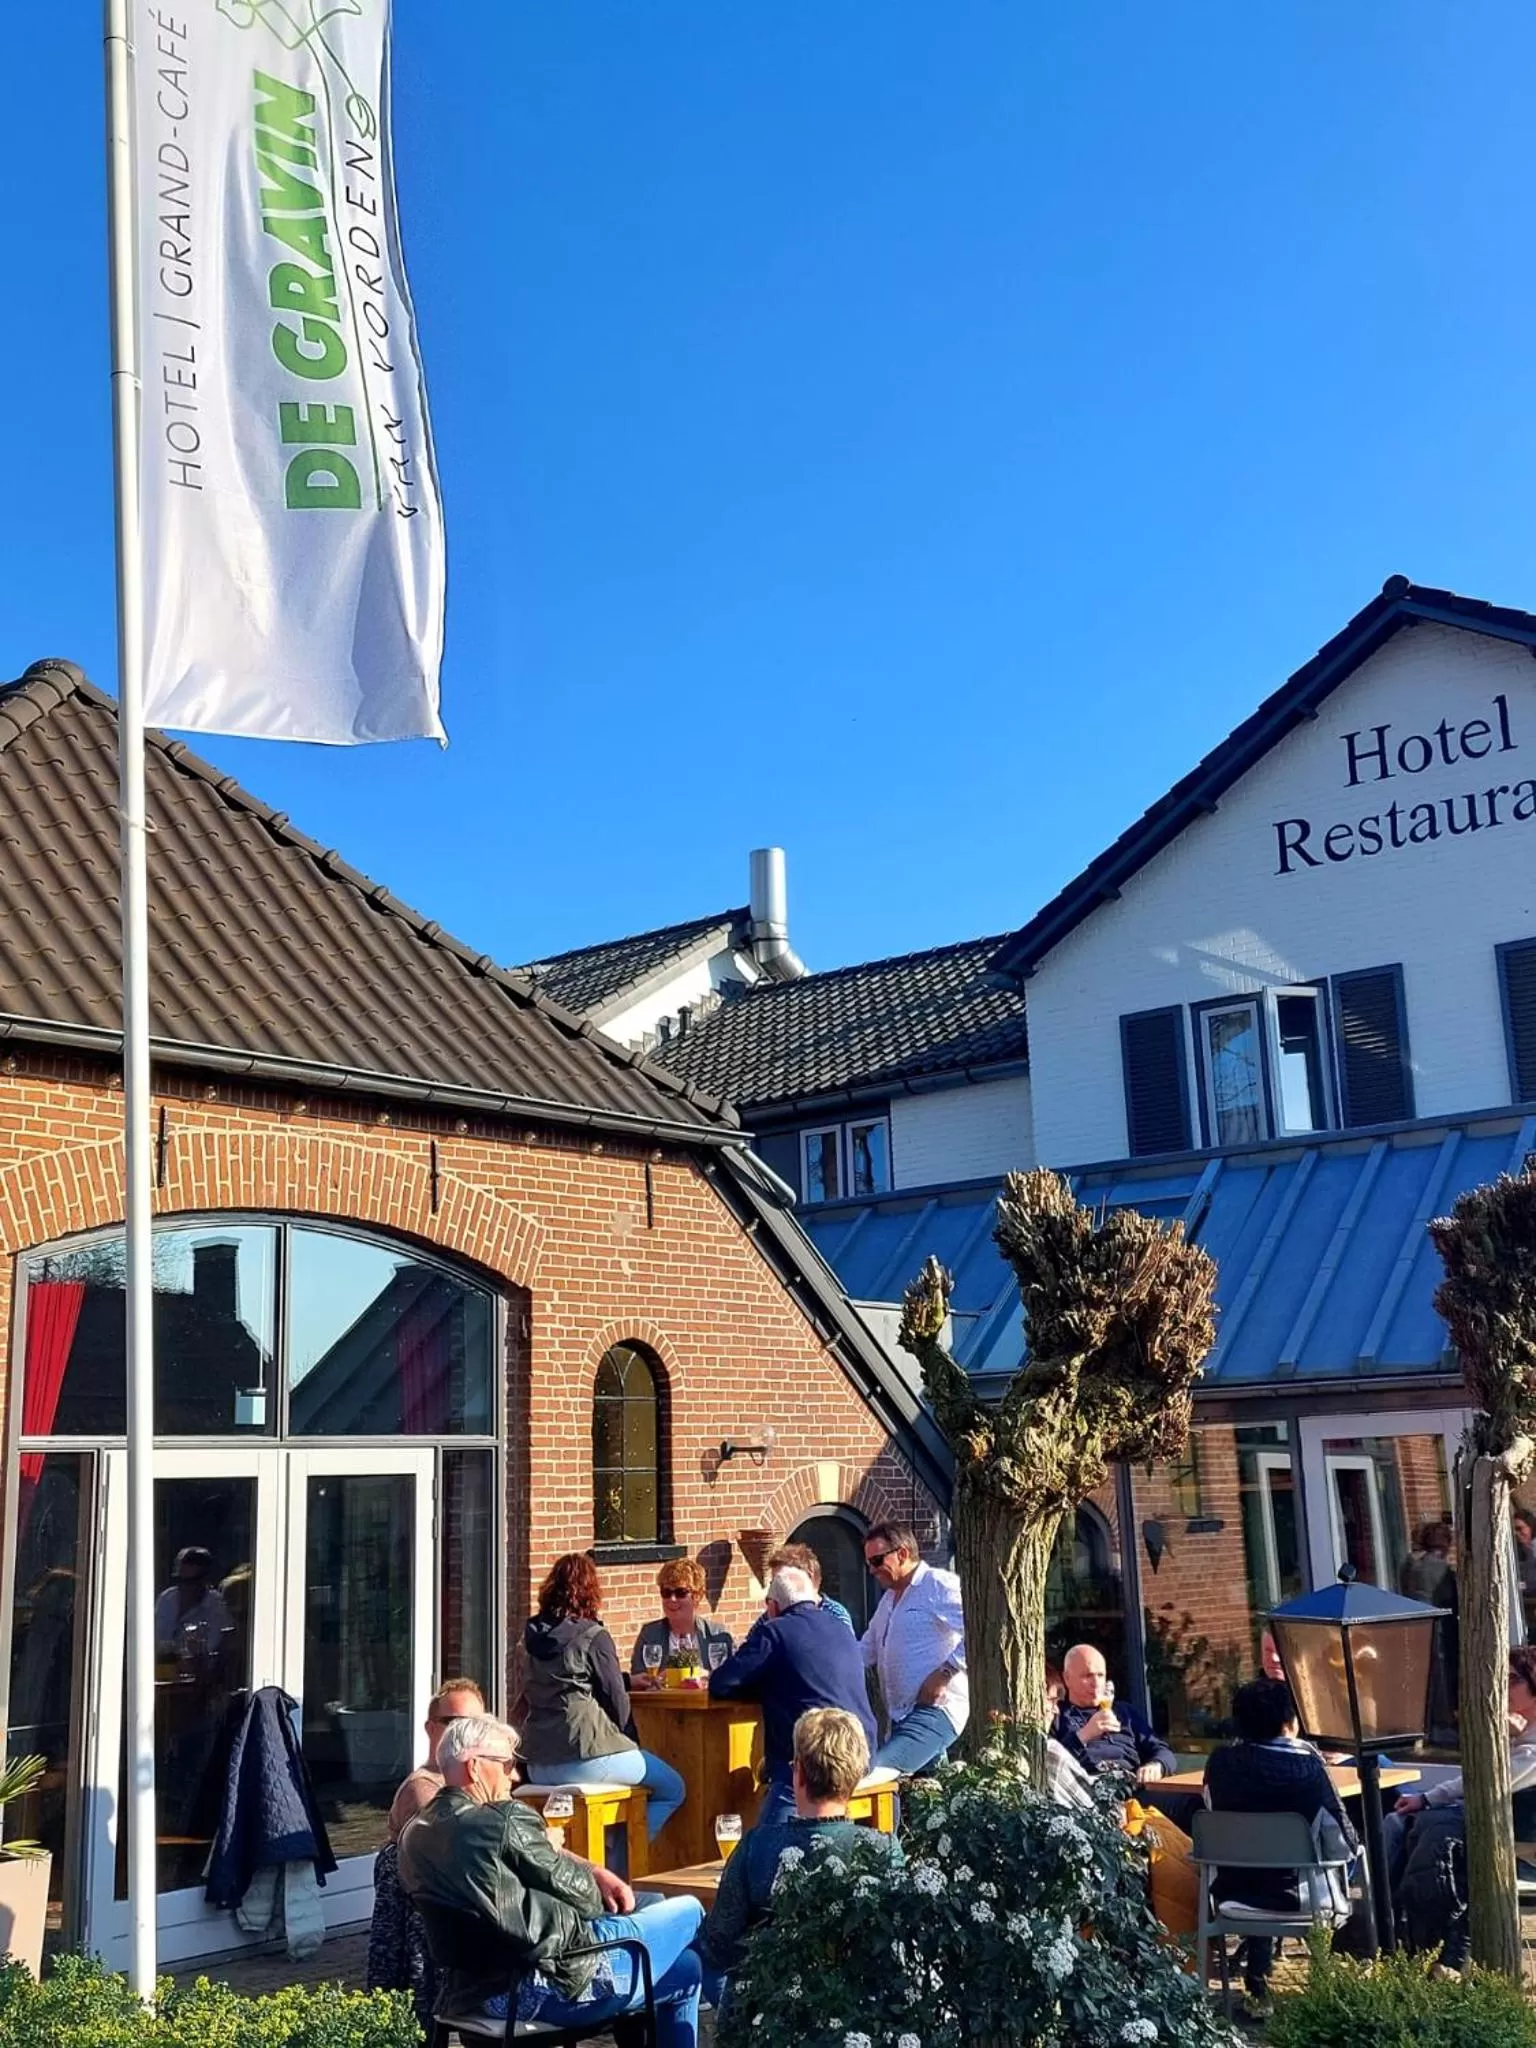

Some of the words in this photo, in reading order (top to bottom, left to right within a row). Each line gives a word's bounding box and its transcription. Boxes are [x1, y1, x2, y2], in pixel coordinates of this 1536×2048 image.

[148, 8, 192, 297] GRAND-CAFÉ
[253, 68, 348, 381] GRAVIN
[345, 139, 394, 373] VORDEN
[163, 345, 203, 490] HOTEL
[279, 402, 362, 510] DE
[380, 403, 418, 518] VAN
[1339, 693, 1519, 788] Hotel
